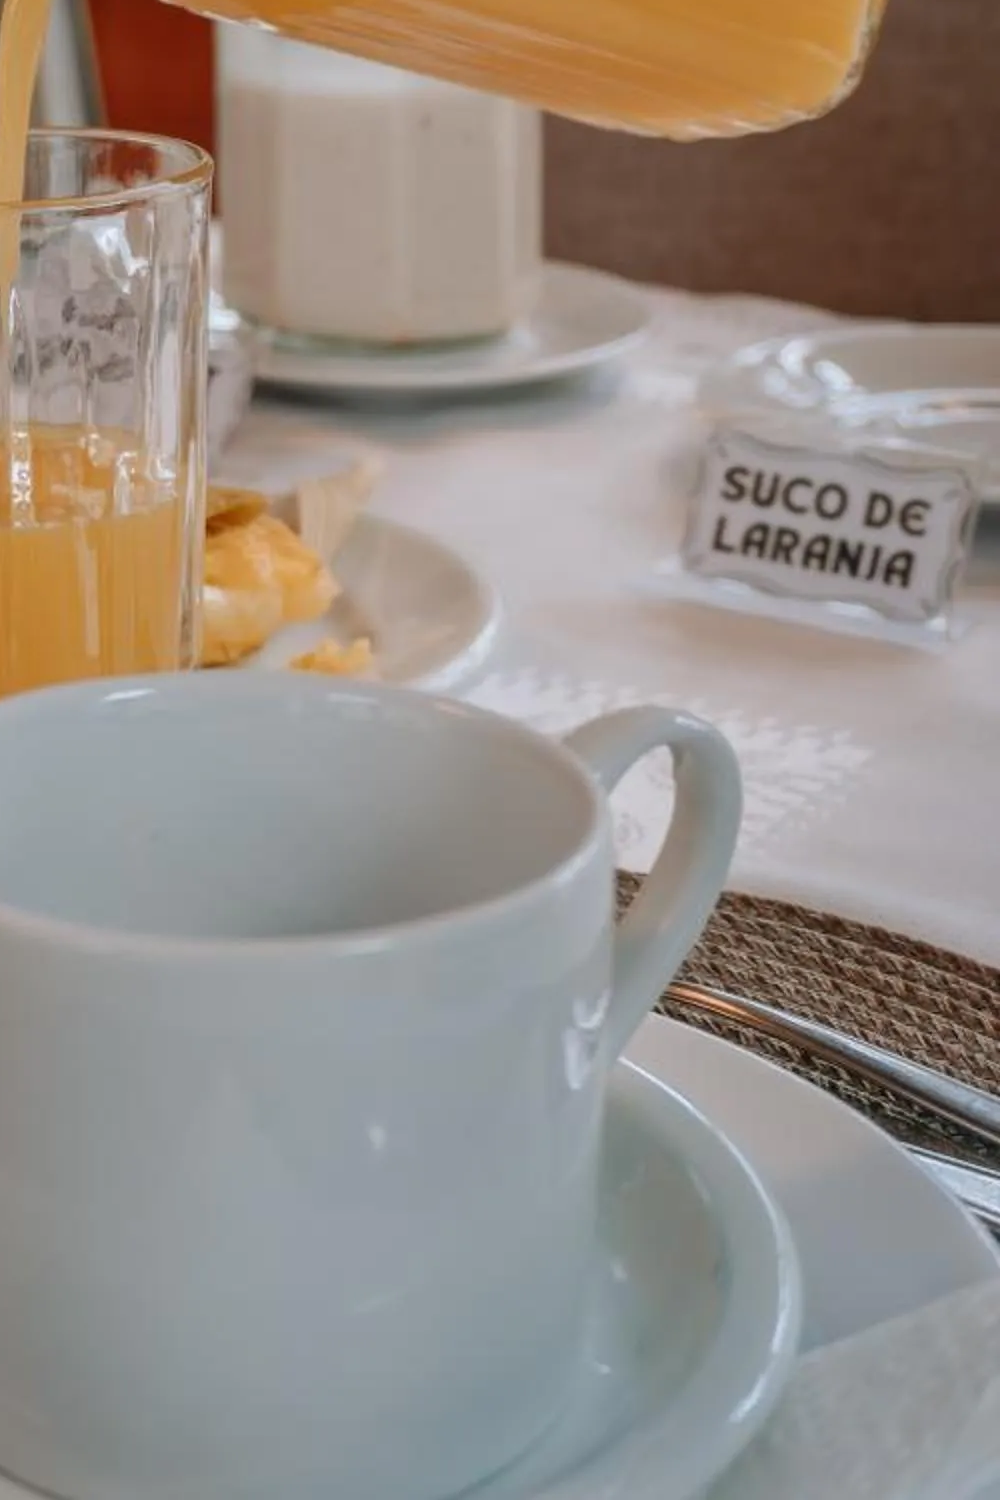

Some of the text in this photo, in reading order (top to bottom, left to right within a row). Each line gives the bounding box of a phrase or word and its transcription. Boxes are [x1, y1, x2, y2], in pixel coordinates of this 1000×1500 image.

[720, 465, 932, 537] SUCO DE
[712, 515, 916, 589] LARANJA
